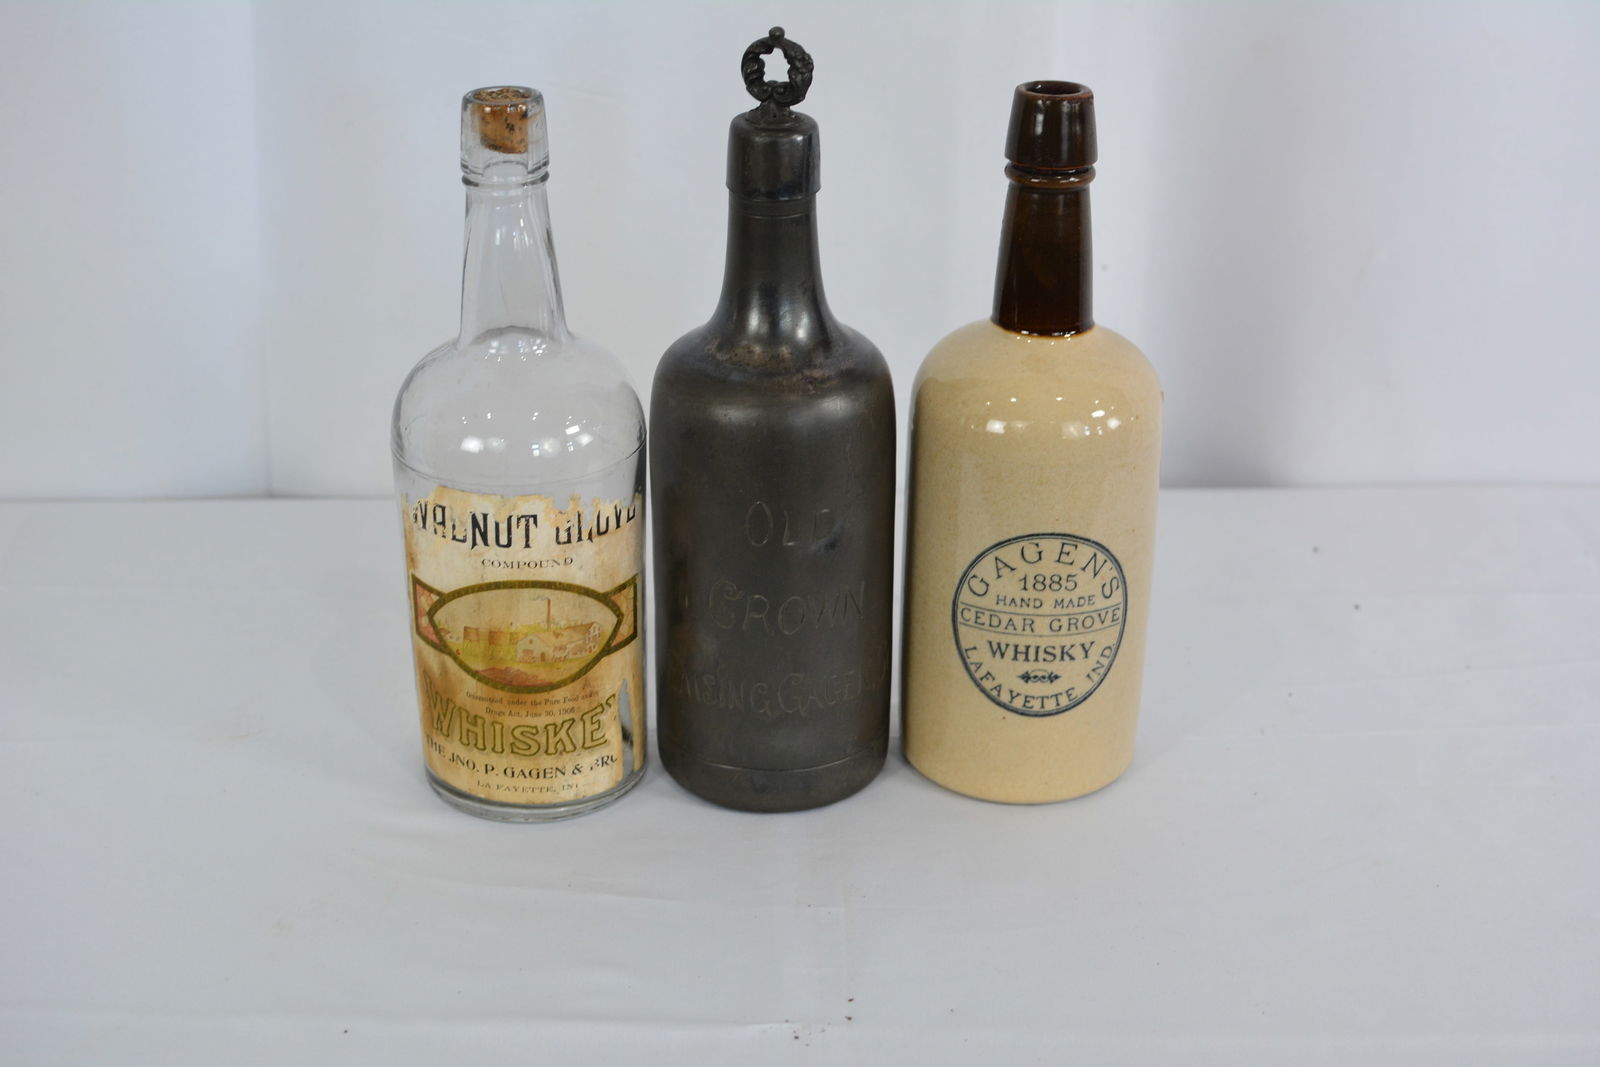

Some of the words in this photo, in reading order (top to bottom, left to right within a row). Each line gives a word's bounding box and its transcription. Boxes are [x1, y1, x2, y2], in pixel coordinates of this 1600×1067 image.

[481, 557, 574, 569] COMPOUND
[966, 541, 1121, 600] GAGEN'S
[1018, 573, 1078, 592] 1885
[996, 594, 1043, 609] HAND
[1053, 594, 1096, 609] MADE
[960, 607, 1036, 633] CEDAR
[1049, 607, 1121, 633] GROVE
[986, 640, 1096, 663] WHISKY
[964, 646, 1079, 709] LAFAYETTE
[426, 733, 446, 758] THE
[448, 752, 480, 772] JNO.
[484, 763, 499, 777] P.
[503, 766, 567, 780] GAGEN
[572, 764, 583, 776] &
[477, 780, 491, 789] LA
